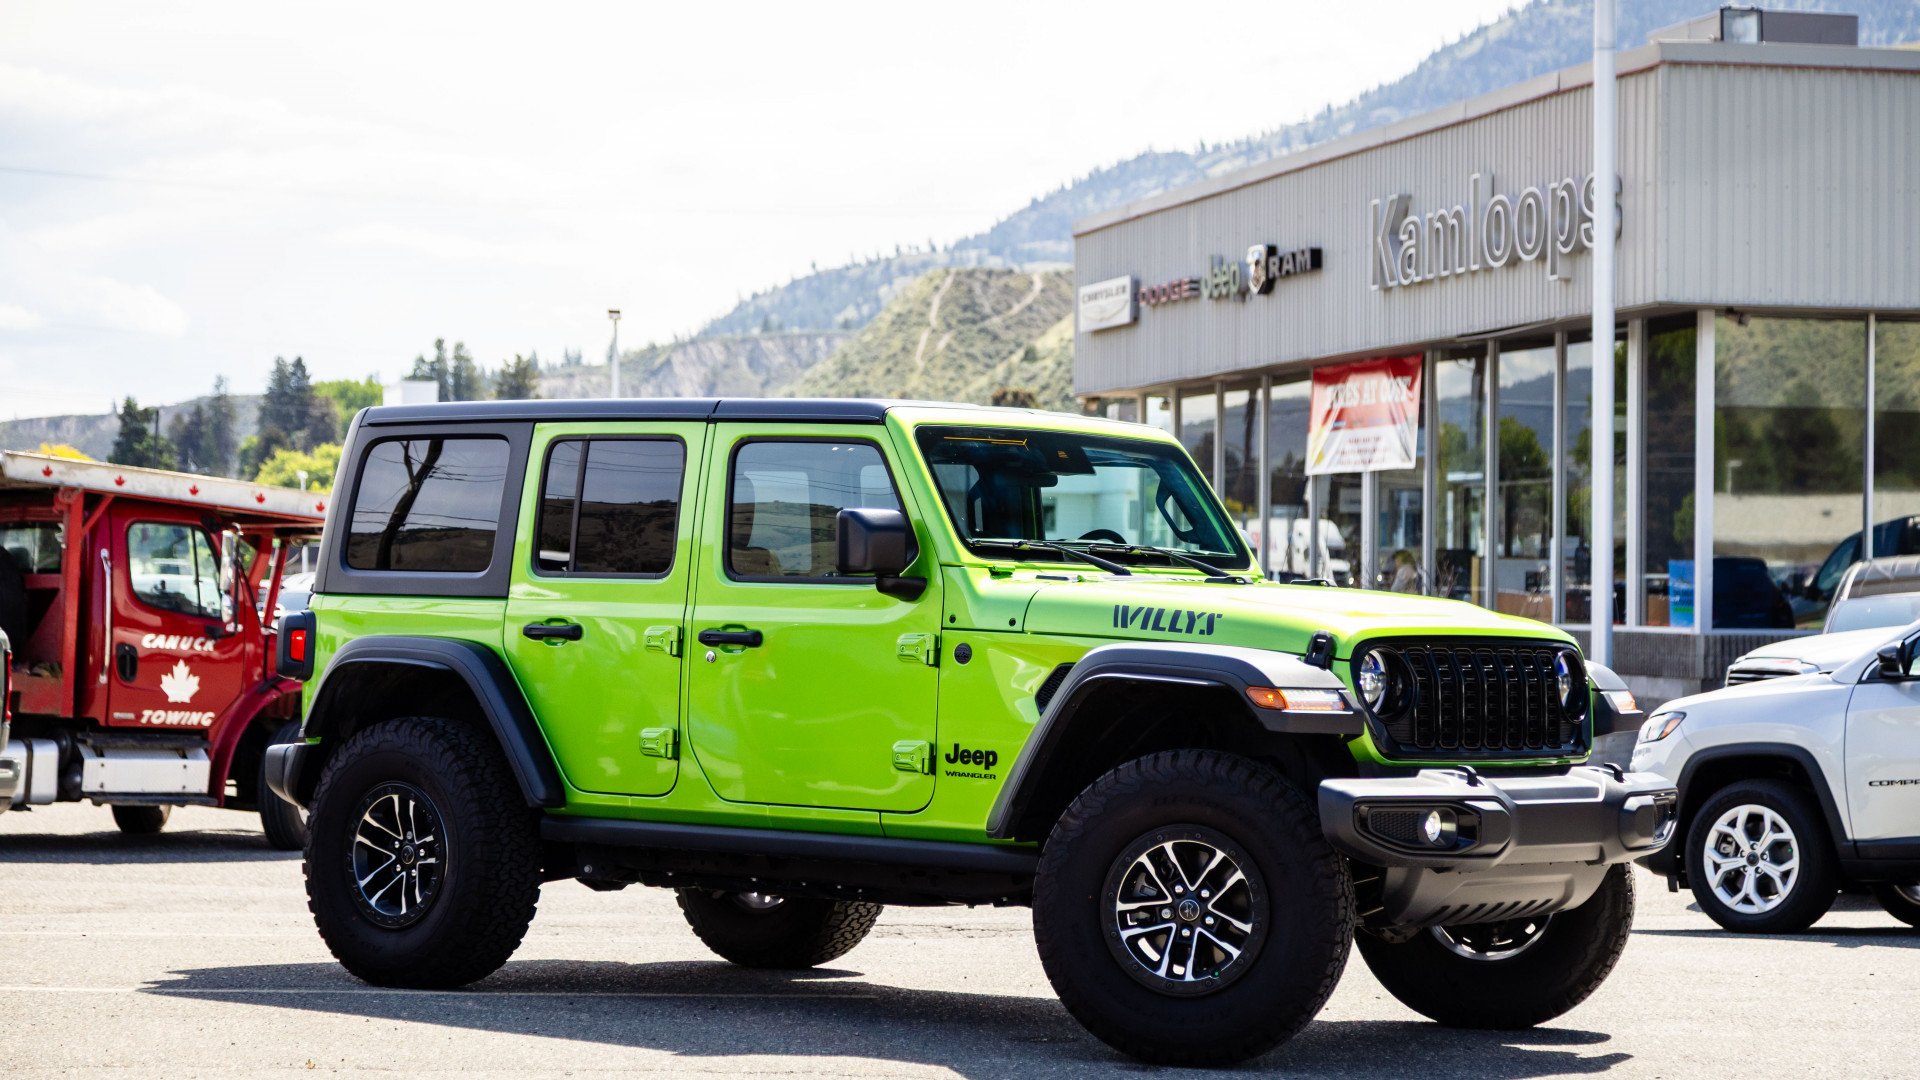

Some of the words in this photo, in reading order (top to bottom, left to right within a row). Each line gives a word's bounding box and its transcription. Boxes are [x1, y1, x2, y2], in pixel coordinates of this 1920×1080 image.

[1370, 172, 1606, 290] Kamloops
[1201, 254, 1242, 302] Jeep
[1268, 250, 1312, 279] RAM
[1081, 283, 1128, 305] CHRYSLER
[1138, 276, 1192, 307] DODGE
[1113, 604, 1223, 636] WILLYS
[141, 633, 216, 651] CANUCK
[140, 709, 215, 726] TOWING
[945, 743, 998, 770] Jeep
[945, 770, 996, 780] WRANGLER
